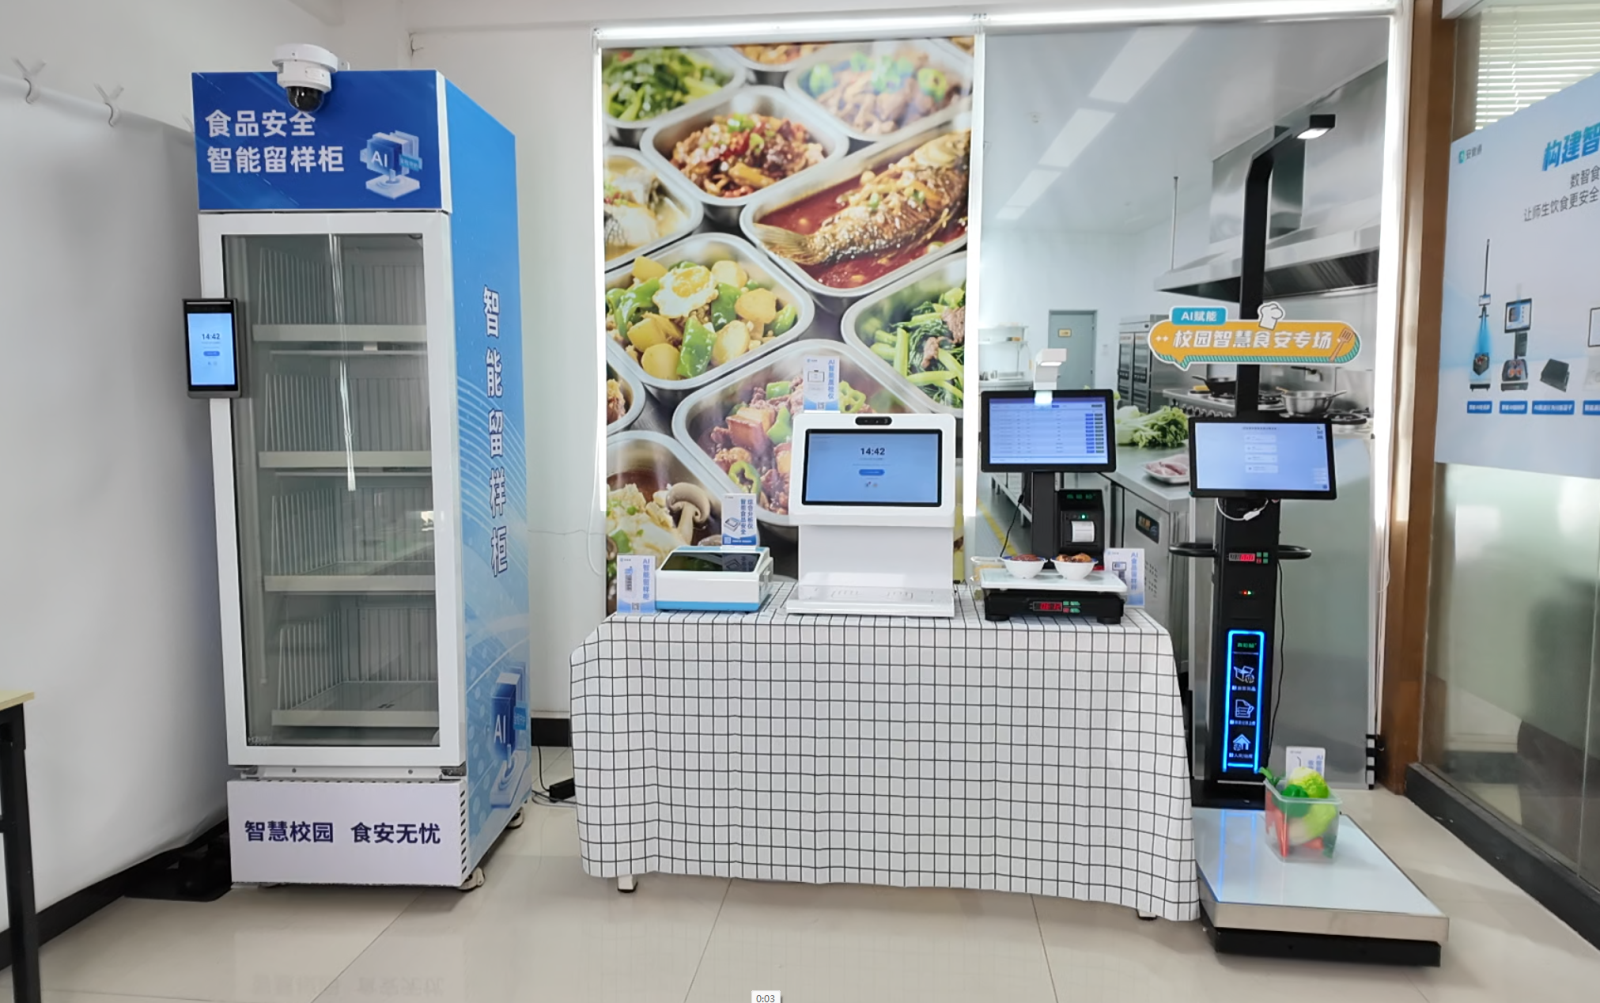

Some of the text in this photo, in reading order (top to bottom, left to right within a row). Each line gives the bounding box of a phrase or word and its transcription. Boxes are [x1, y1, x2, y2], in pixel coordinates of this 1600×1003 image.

[205, 109, 317, 138] 食品安全
[206, 145, 345, 174] 智能留样柜
[370, 150, 388, 168] AI
[1180, 310, 1218, 322] AI赋能
[1172, 329, 1333, 349] 校园智慧食安专场
[483, 284, 508, 577] 智能留样柜
[859, 447, 886, 456] 14:42
[493, 714, 507, 744] AI
[244, 820, 441, 844] 智慧校园 食安无忧
